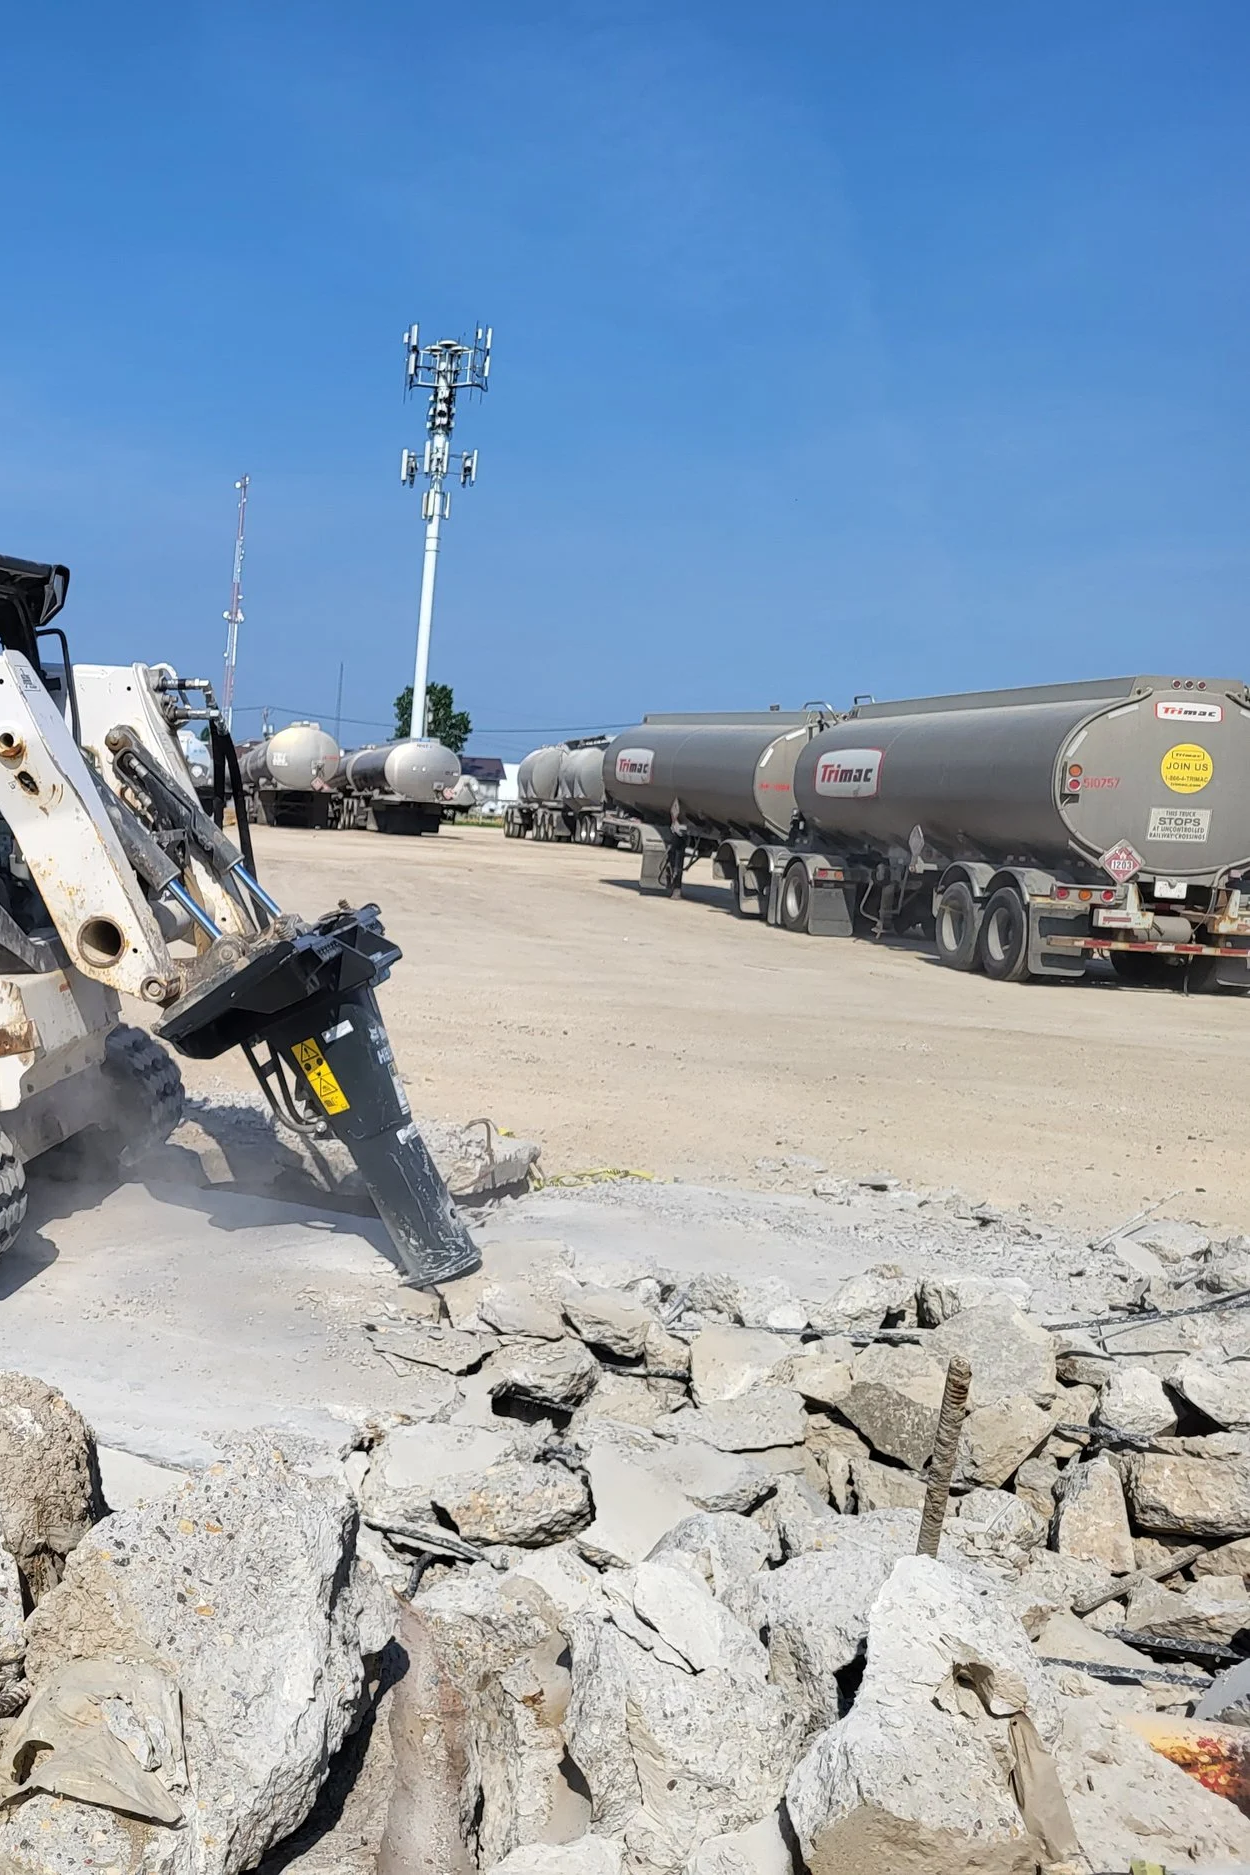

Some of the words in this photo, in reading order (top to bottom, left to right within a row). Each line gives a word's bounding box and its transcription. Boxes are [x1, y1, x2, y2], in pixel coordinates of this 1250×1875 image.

[1162, 707, 1217, 717] Trimac
[619, 758, 649, 774] Trimac
[1166, 762, 1191, 771] JOIN
[1194, 763, 1209, 771] US
[820, 764, 873, 783] Trimac
[1083, 777, 1120, 789] 510757
[1158, 817, 1201, 826] STOPS
[1113, 861, 1132, 869] 1203
